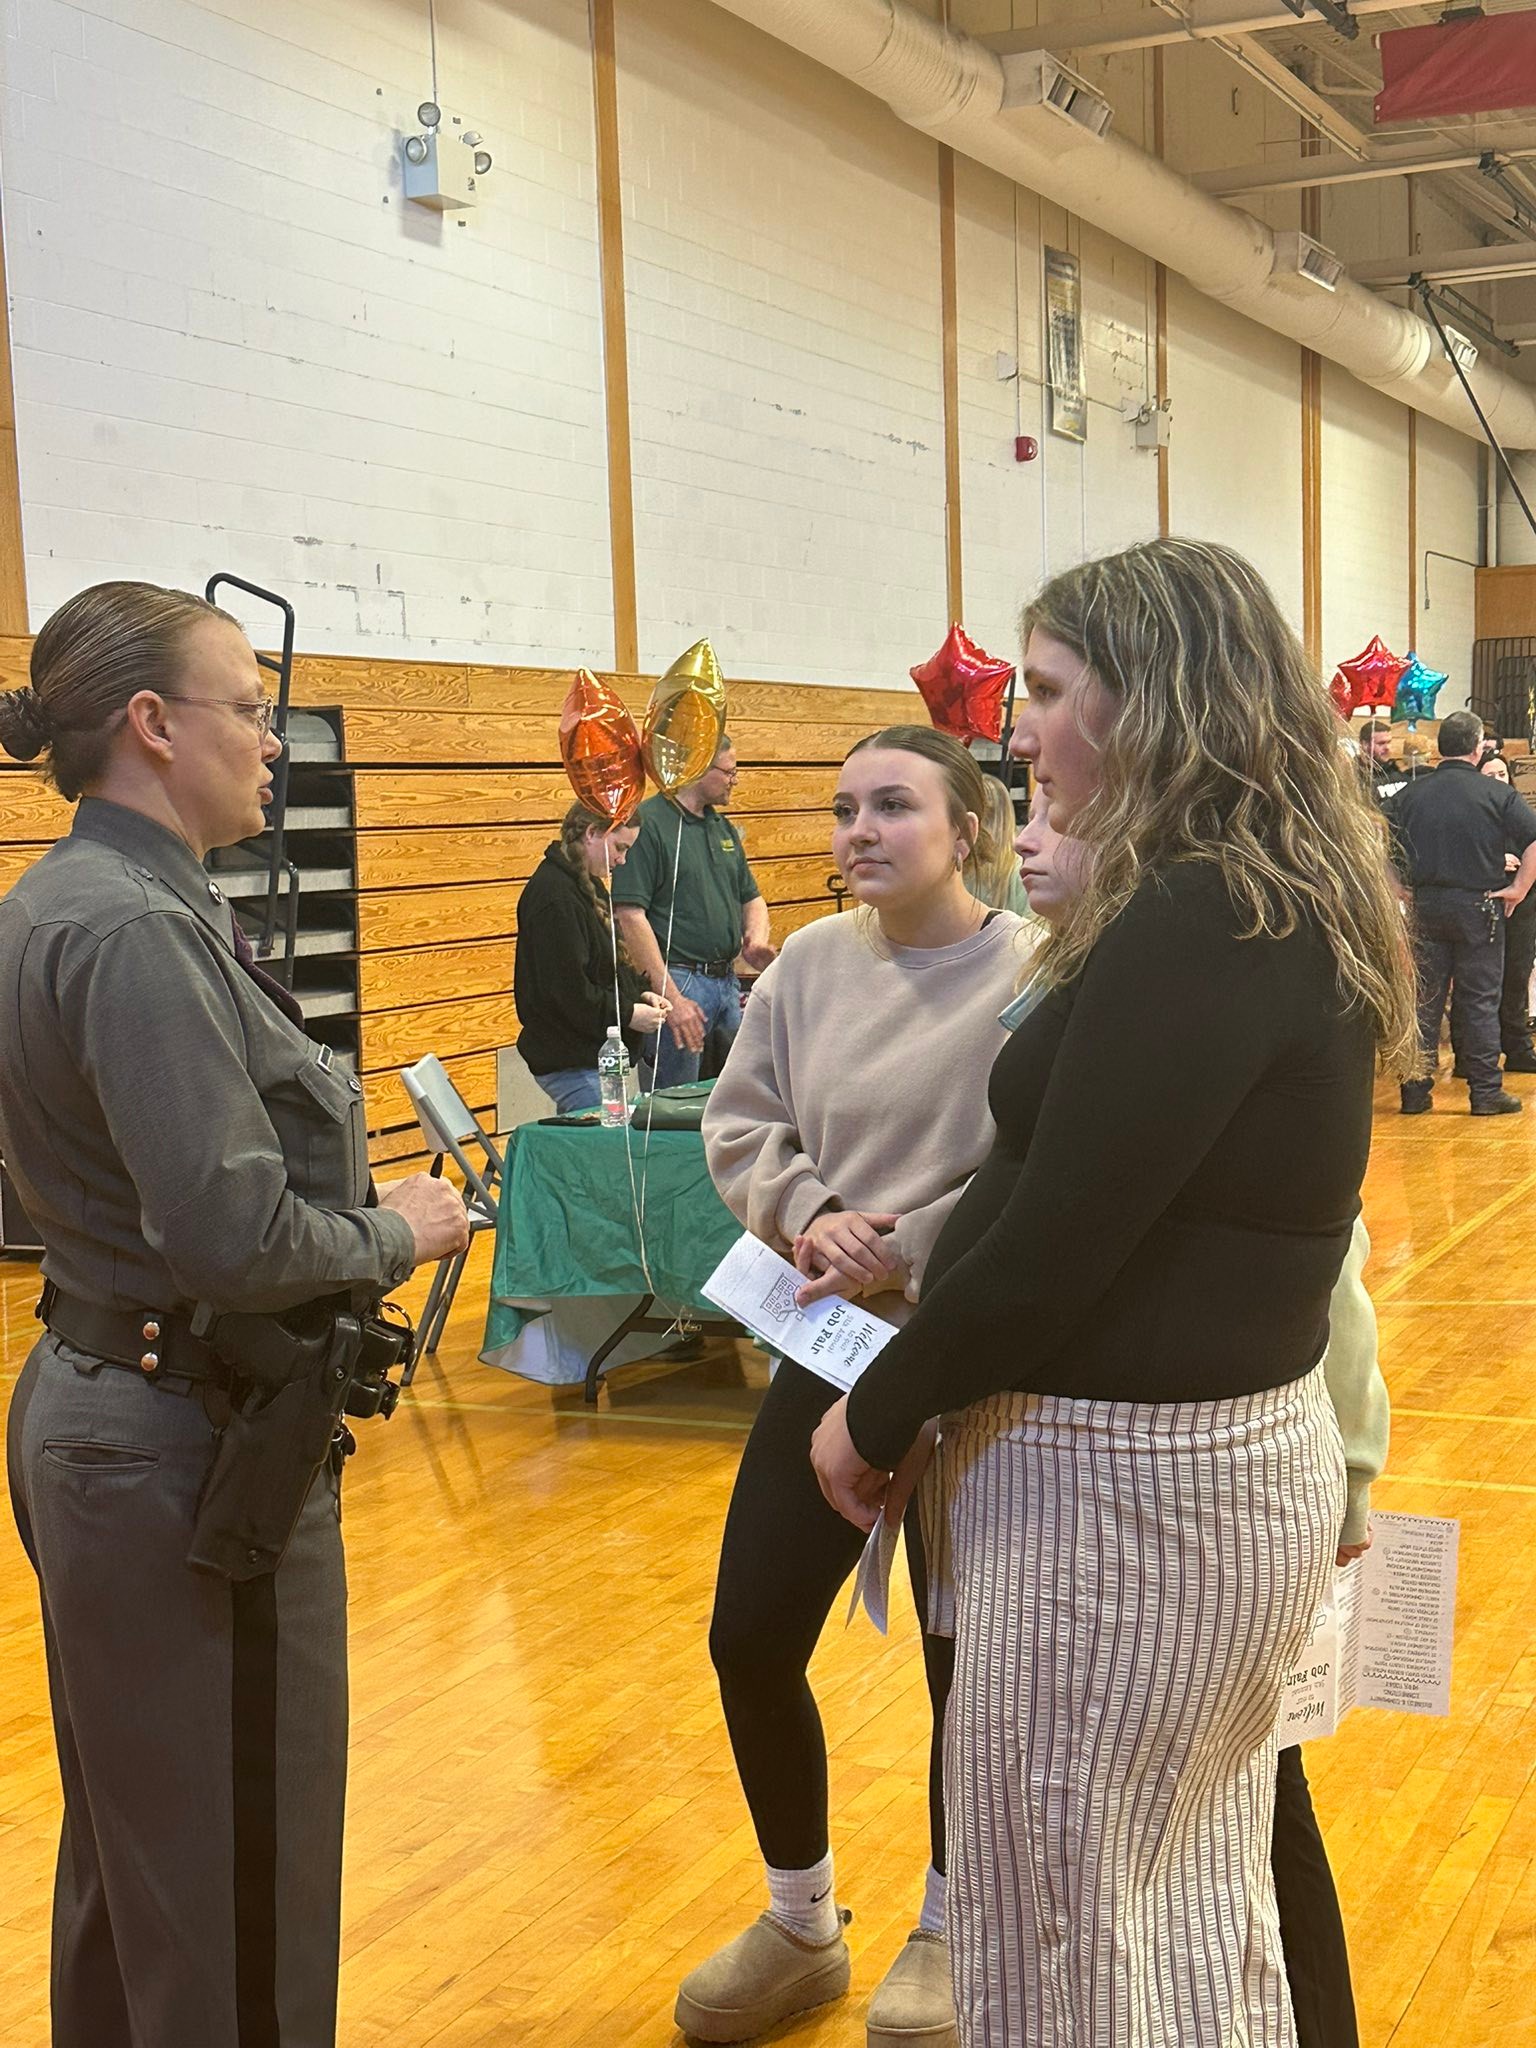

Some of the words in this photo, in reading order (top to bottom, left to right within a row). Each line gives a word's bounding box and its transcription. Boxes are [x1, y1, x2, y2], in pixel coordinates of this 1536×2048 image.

[826, 1304, 847, 1327] Job
[810, 1328, 834, 1355] Fair
[843, 1323, 878, 1367] Welcome
[1286, 1669, 1309, 1686] Fair
[1310, 1662, 1330, 1678] Job
[1286, 1700, 1326, 1723] Welcome
